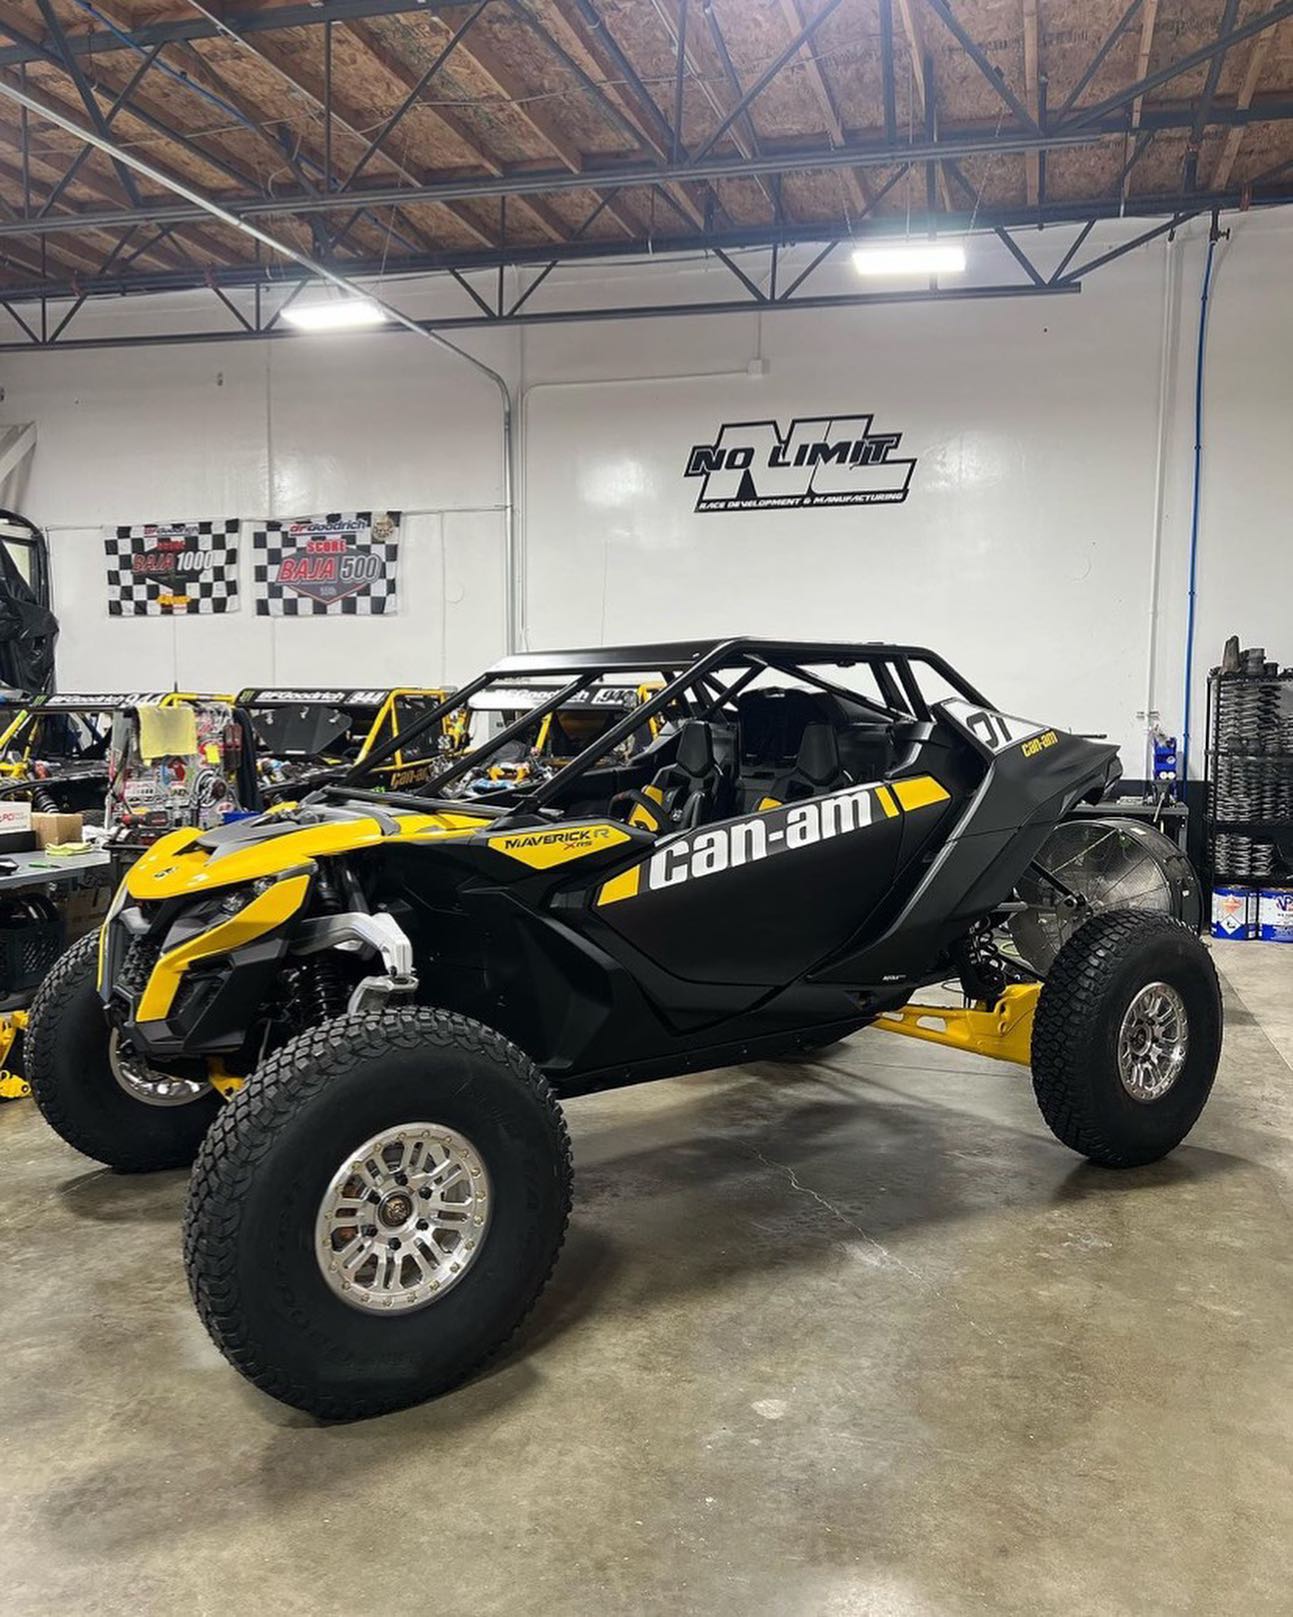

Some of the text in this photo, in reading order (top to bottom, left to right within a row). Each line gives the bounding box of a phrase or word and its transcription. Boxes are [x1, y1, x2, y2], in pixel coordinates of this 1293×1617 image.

[690, 436, 896, 472] NO LIMIT
[699, 501, 726, 510] RACE
[727, 497, 802, 508] DEVELOPMENT
[813, 492, 903, 503] MANUFACTURING
[306, 539, 347, 553] SCORE
[132, 551, 214, 574] BAJA 1000
[278, 554, 382, 582] BAJA 500
[505, 830, 590, 850] MAVERICK
